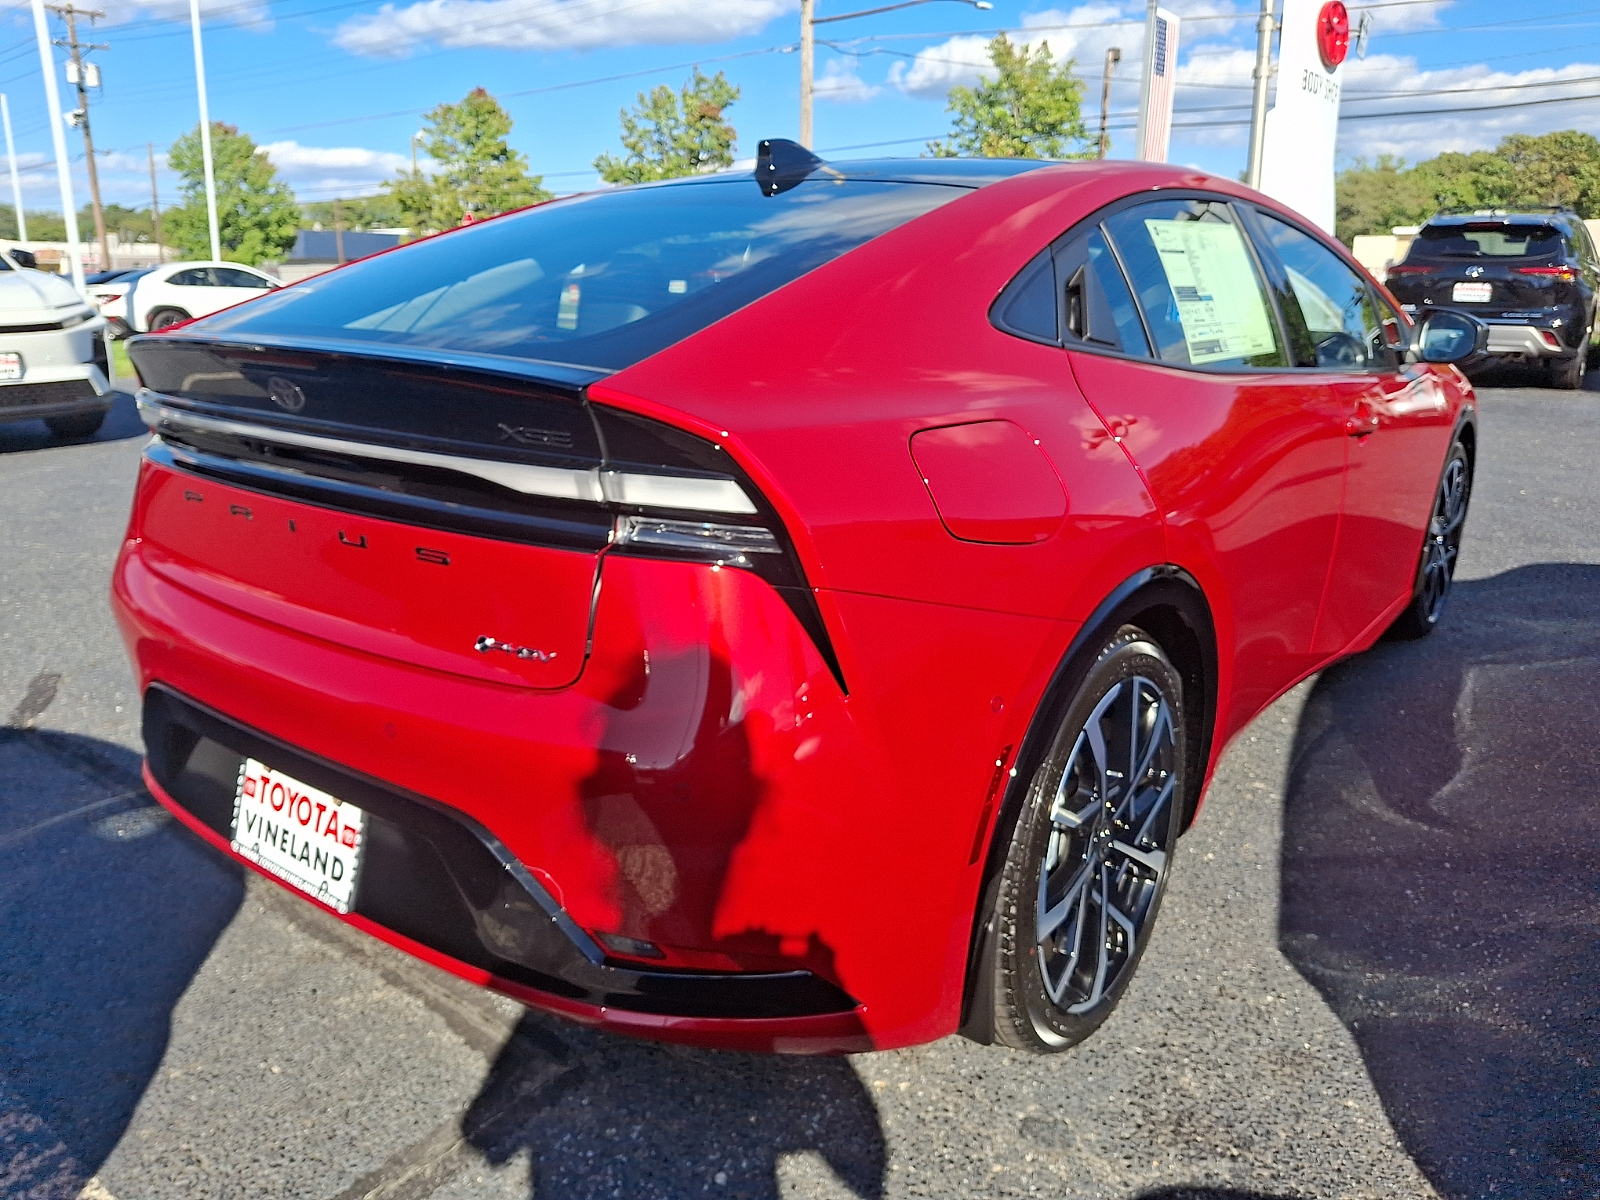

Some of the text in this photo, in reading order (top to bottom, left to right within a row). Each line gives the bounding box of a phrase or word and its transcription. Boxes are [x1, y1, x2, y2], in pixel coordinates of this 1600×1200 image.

[1302, 69, 1323, 94] BODY
[498, 423, 573, 448] XSE
[184, 490, 450, 566] PRIUS
[260, 775, 339, 843] TOYOTA
[245, 809, 344, 881] VINELAND
